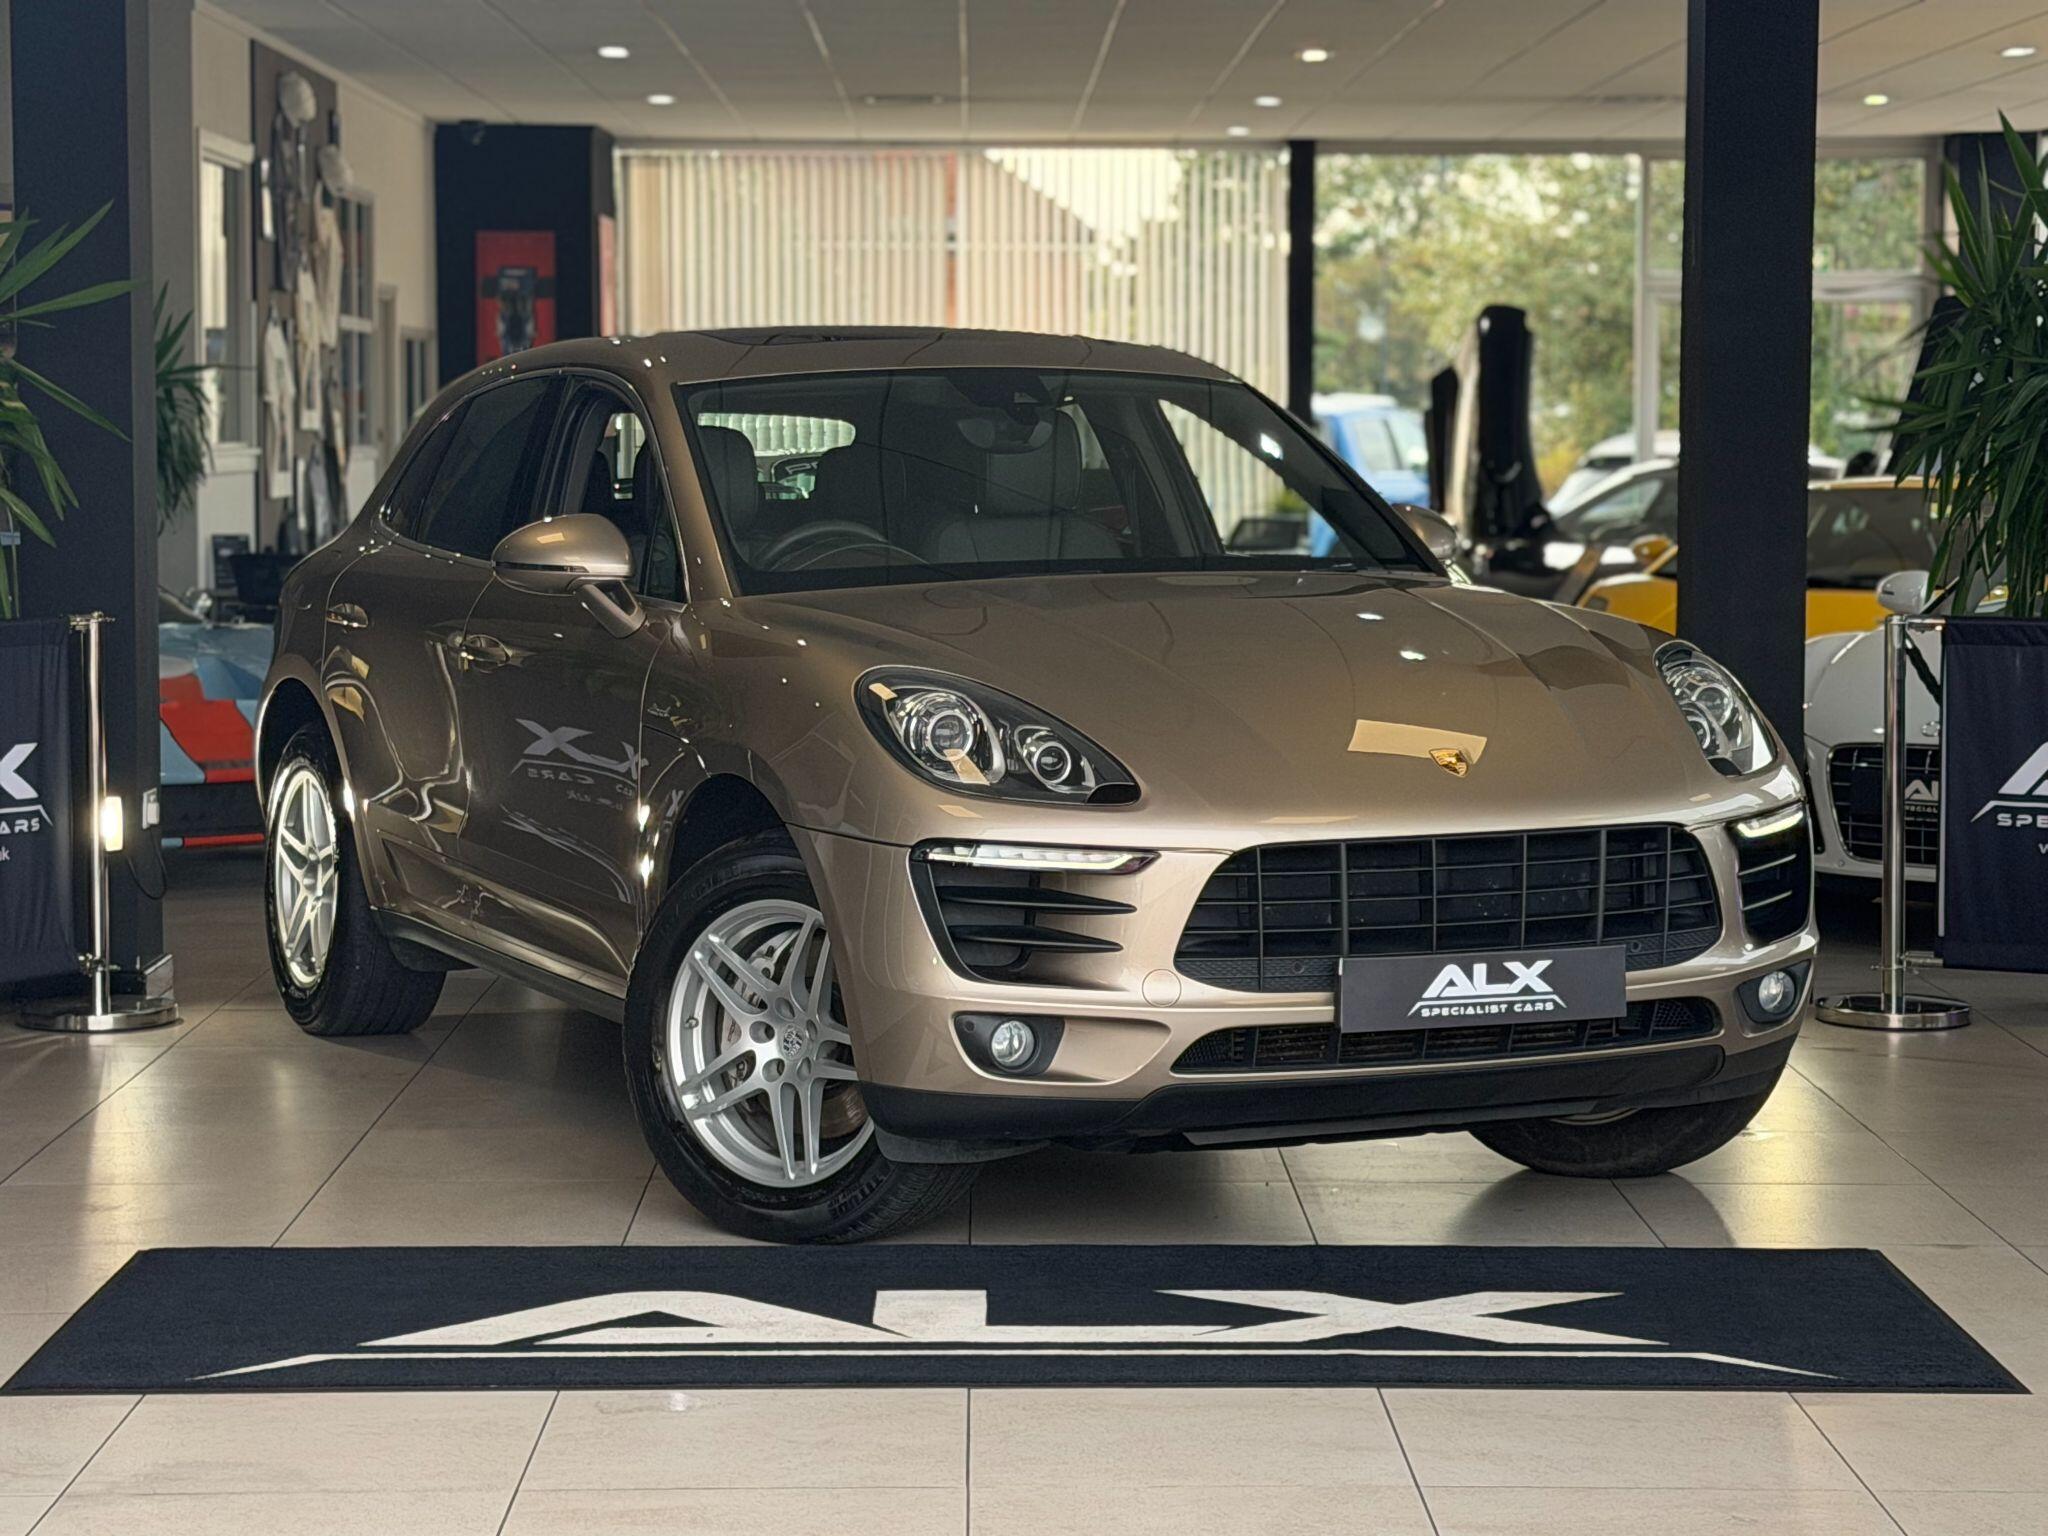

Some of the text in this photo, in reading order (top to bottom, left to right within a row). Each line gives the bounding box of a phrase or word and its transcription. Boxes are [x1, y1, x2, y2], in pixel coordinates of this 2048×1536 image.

[1421, 959, 1554, 998] ALX
[1421, 1001, 1554, 1017] SPECIALIST CARS
[356, 1290, 1670, 1346] ALX
